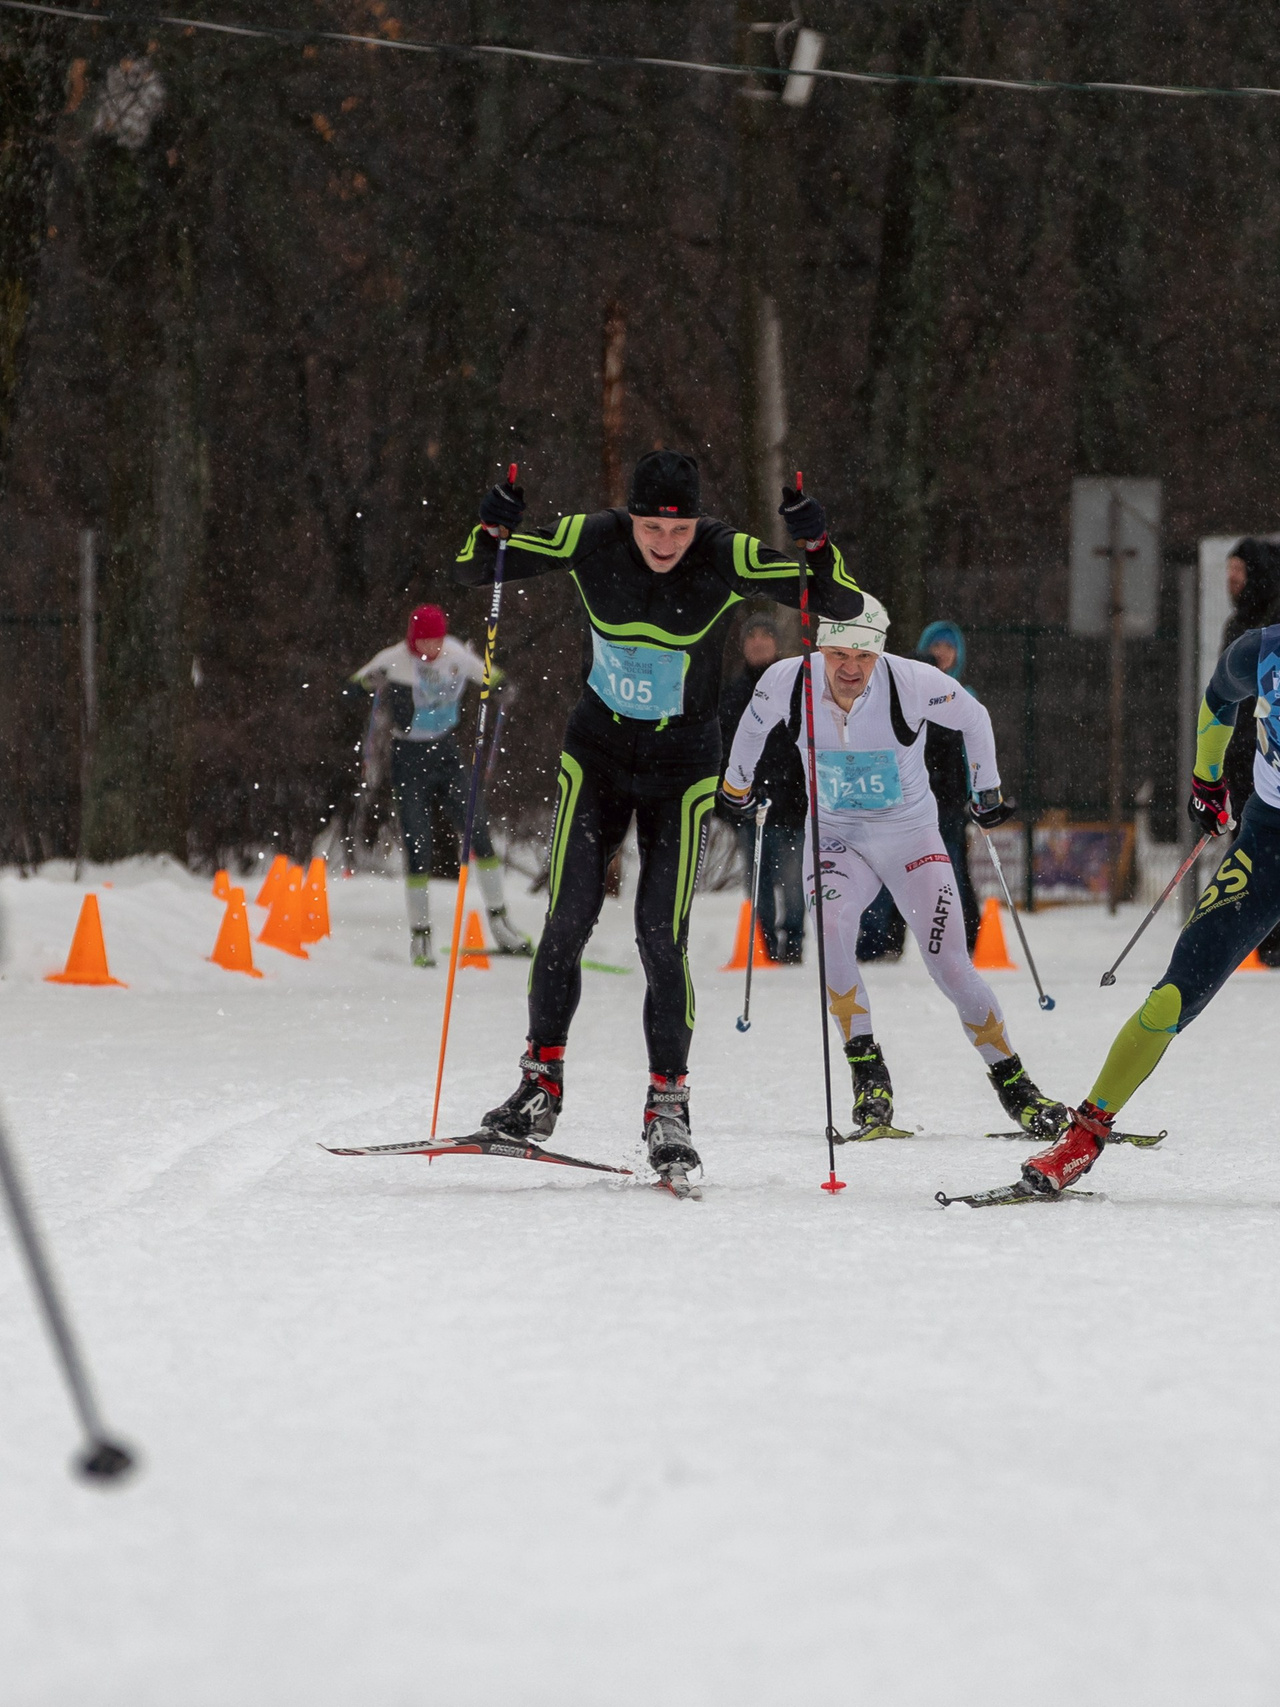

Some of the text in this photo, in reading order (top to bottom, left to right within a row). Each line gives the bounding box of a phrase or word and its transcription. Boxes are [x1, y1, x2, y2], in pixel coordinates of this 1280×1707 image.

[608, 672, 653, 704] 105
[830, 774, 885, 798] 1215
[1191, 890, 1250, 923] COMPRESSION
[928, 896, 954, 955] CRAFT
[1062, 1153, 1090, 1176] alpina
